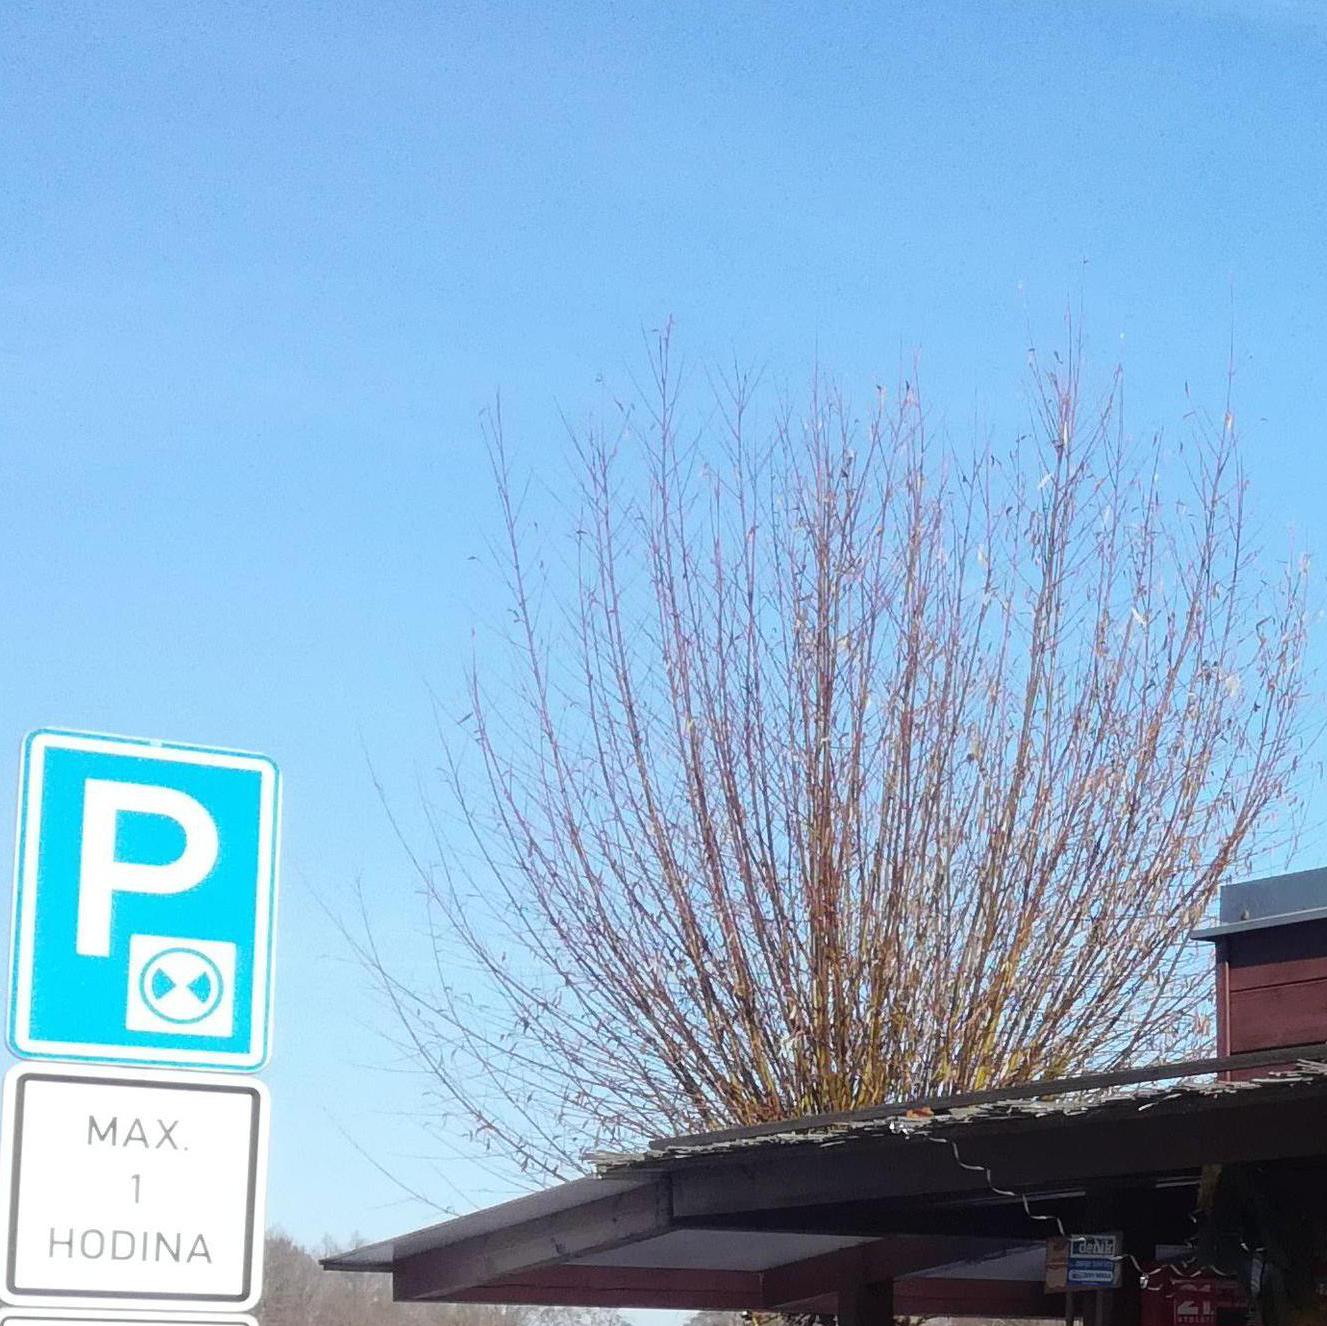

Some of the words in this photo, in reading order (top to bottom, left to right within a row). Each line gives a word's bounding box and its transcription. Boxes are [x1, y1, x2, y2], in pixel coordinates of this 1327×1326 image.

[76, 778, 219, 958] P
[87, 1114, 189, 1152] MAX.
[130, 1173, 142, 1204] 1
[48, 1226, 213, 1265] HODINA
